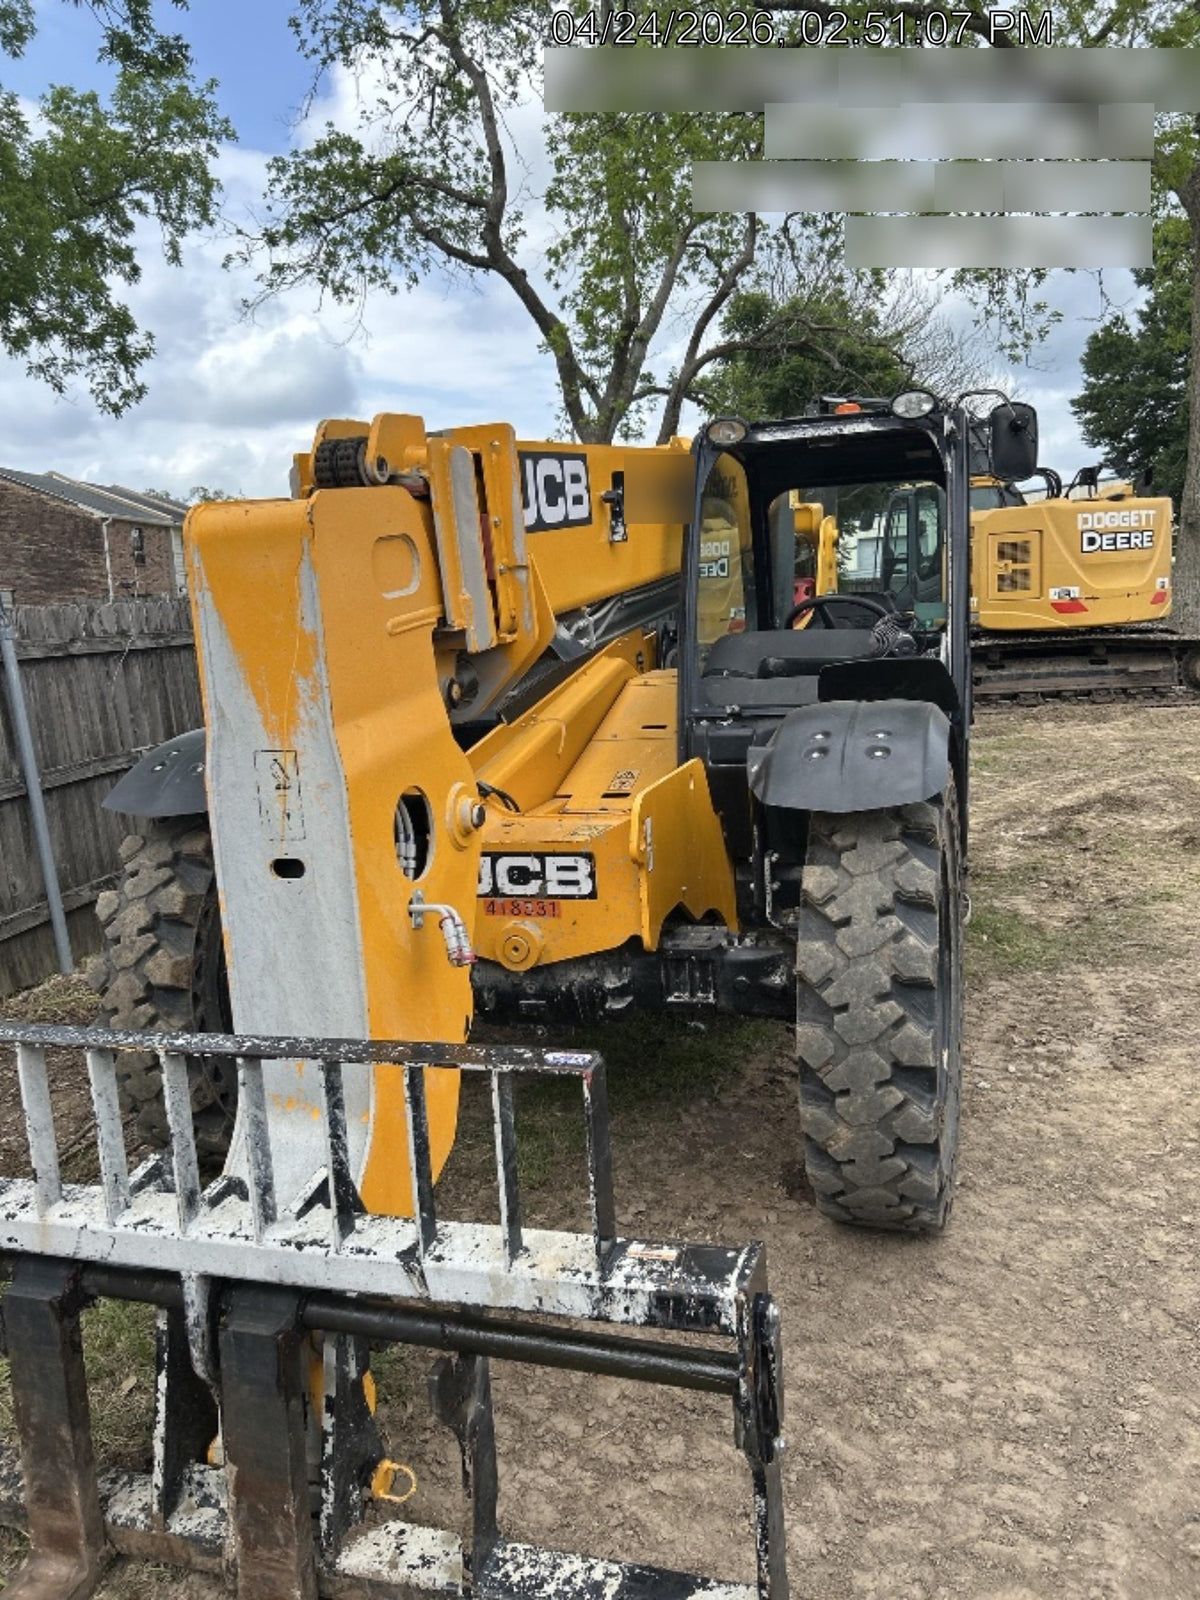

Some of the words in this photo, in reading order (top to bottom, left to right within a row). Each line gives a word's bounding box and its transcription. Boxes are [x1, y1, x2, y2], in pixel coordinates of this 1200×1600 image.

[523, 458, 590, 526] JCB
[1077, 511, 1156, 529] DOGGETT
[1081, 529, 1155, 553] DEERE
[477, 855, 593, 895] JCB
